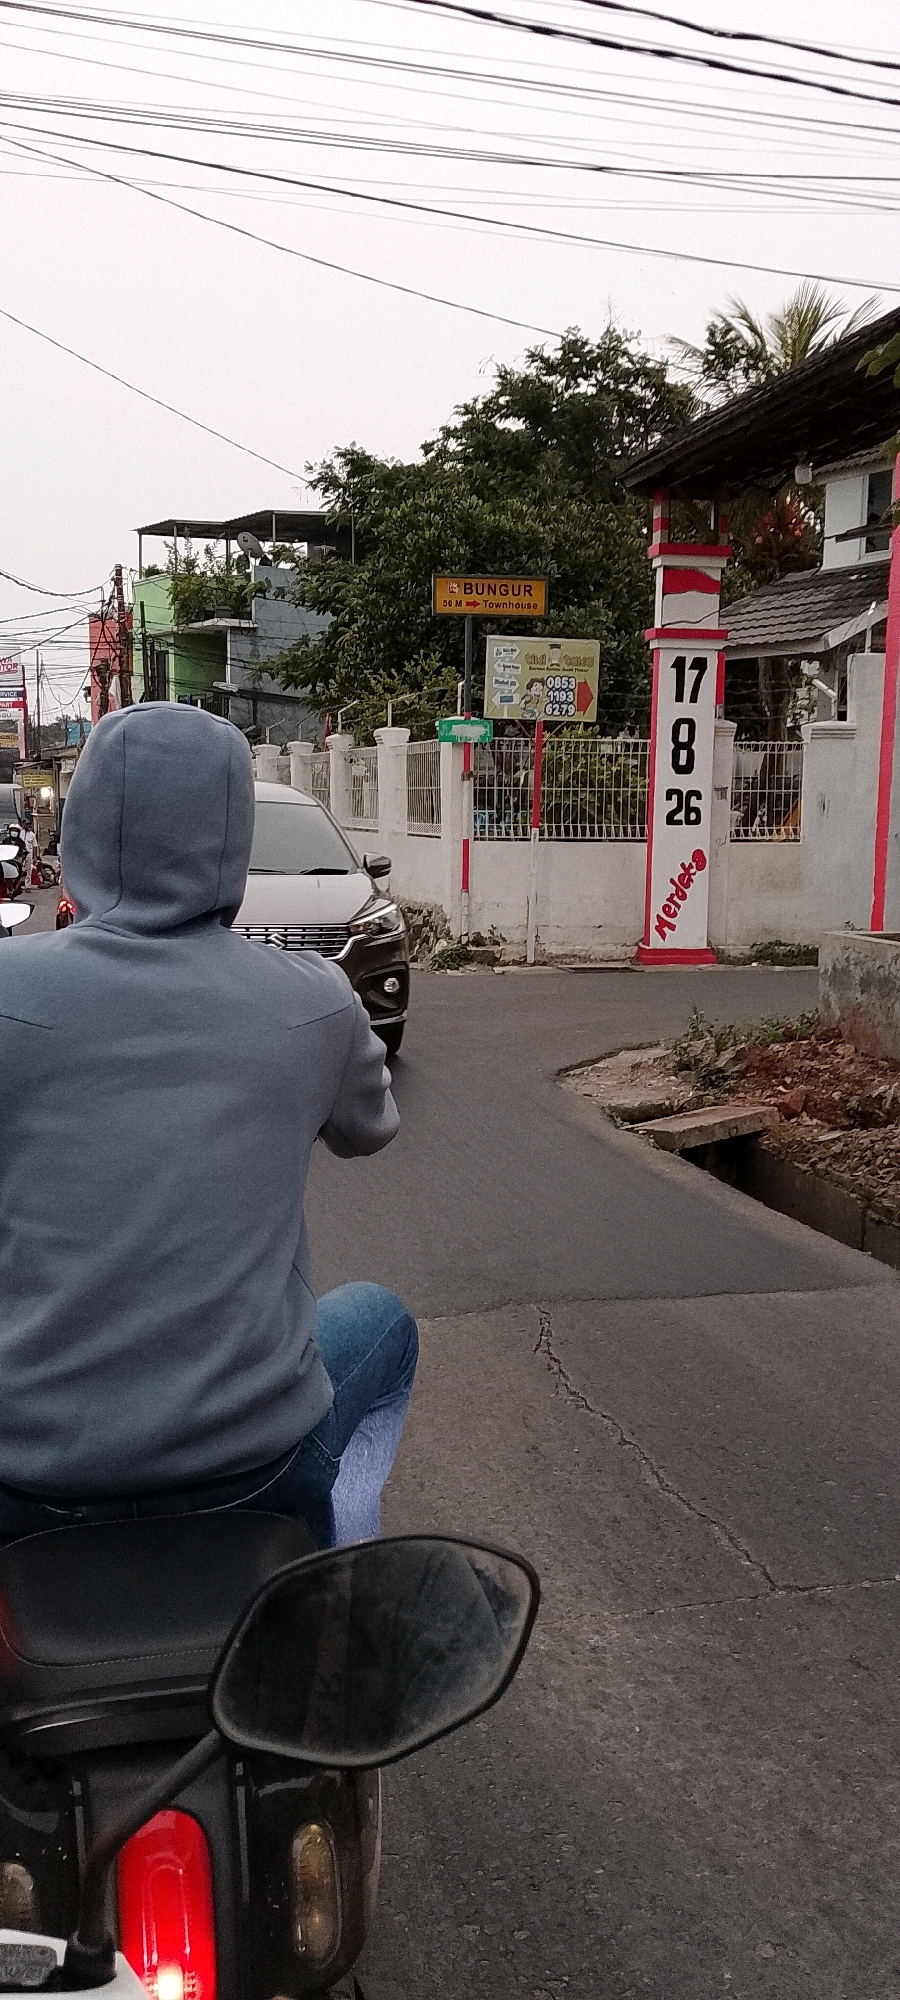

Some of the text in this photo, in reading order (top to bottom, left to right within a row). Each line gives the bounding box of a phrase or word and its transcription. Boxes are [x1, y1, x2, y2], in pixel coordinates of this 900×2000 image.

[463, 582, 533, 597] BUNGUR
[443, 600, 538, 610] 50 M Townhouse
[546, 675, 576, 690] 0853
[670, 656, 708, 703] 17
[547, 690, 575, 702] 1193
[545, 702, 576, 717] 6279
[672, 718, 696, 774] 8
[665, 788, 702, 826] 26
[654, 848, 707, 942] Merdeka
